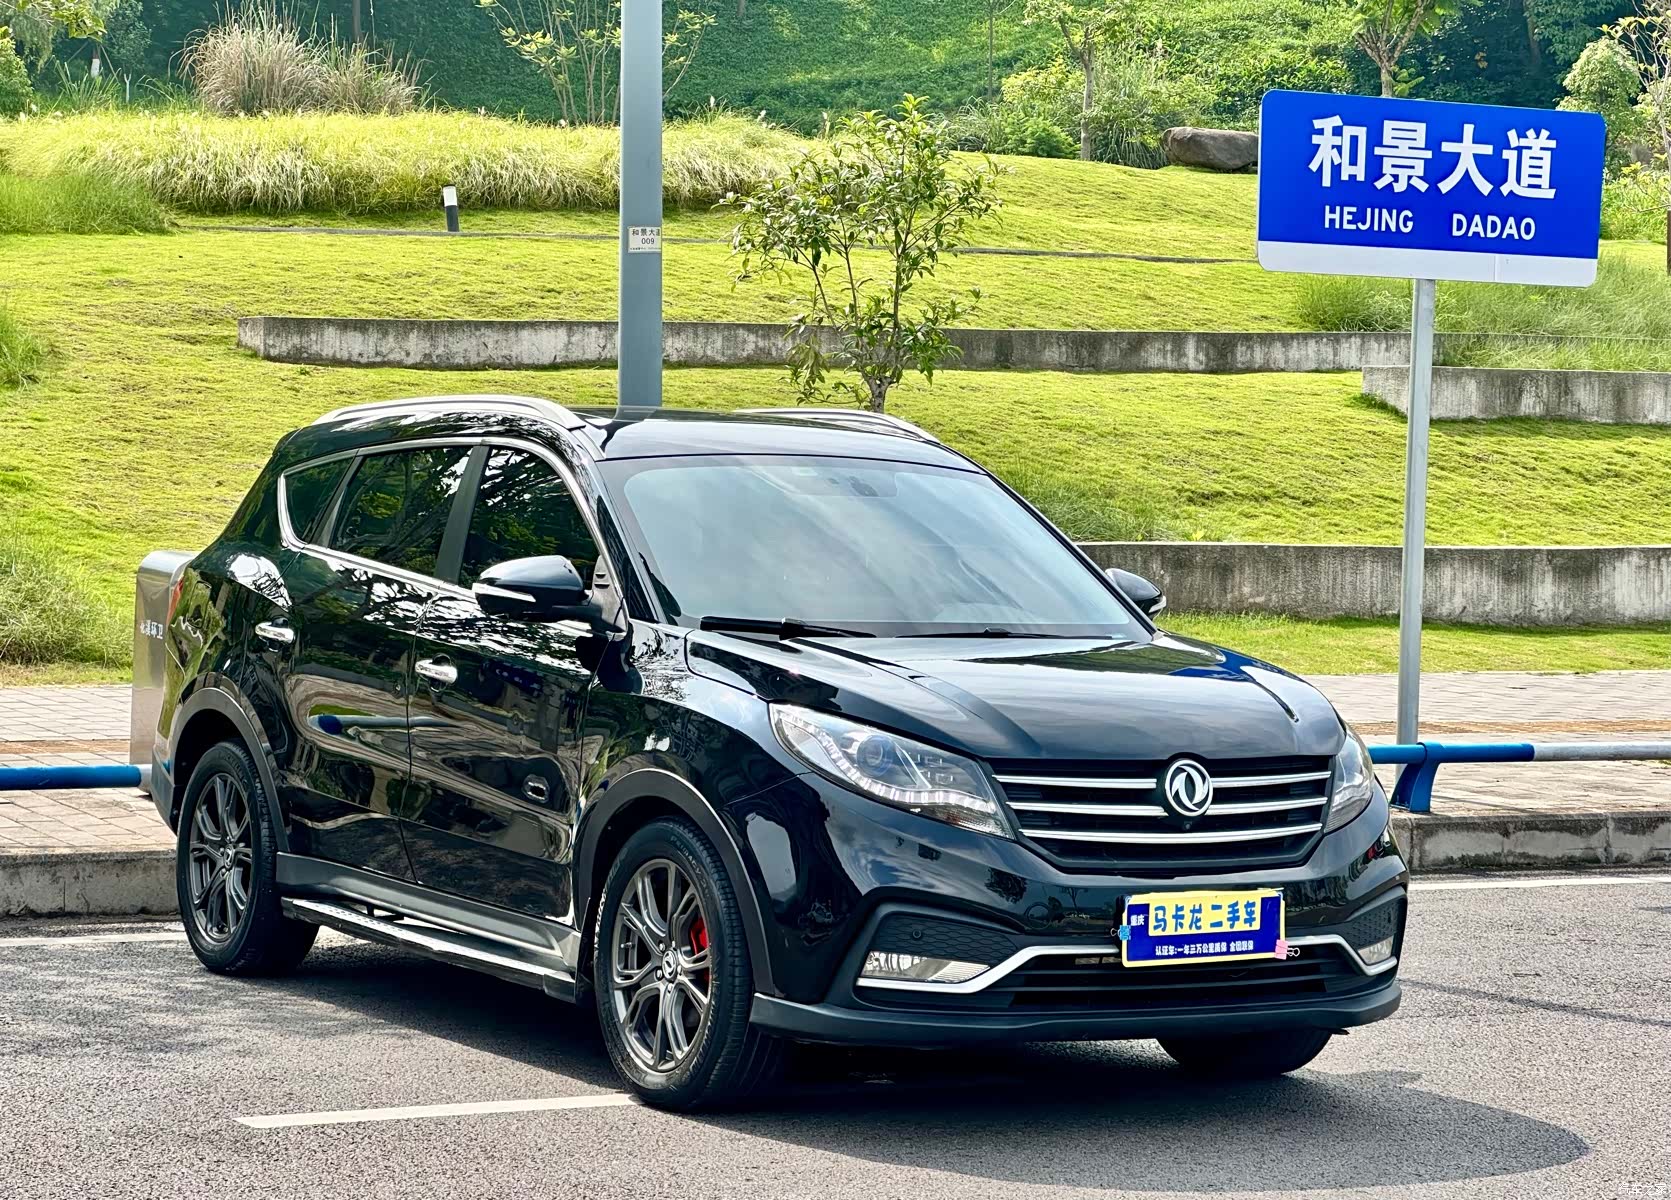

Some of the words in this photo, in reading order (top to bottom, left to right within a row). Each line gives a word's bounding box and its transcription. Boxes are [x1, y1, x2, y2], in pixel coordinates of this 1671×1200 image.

[1307, 114, 1557, 199] 和景大道
[1323, 204, 1414, 233] HEJING
[1451, 213, 1536, 240] DADAO
[641, 237, 655, 245] 009
